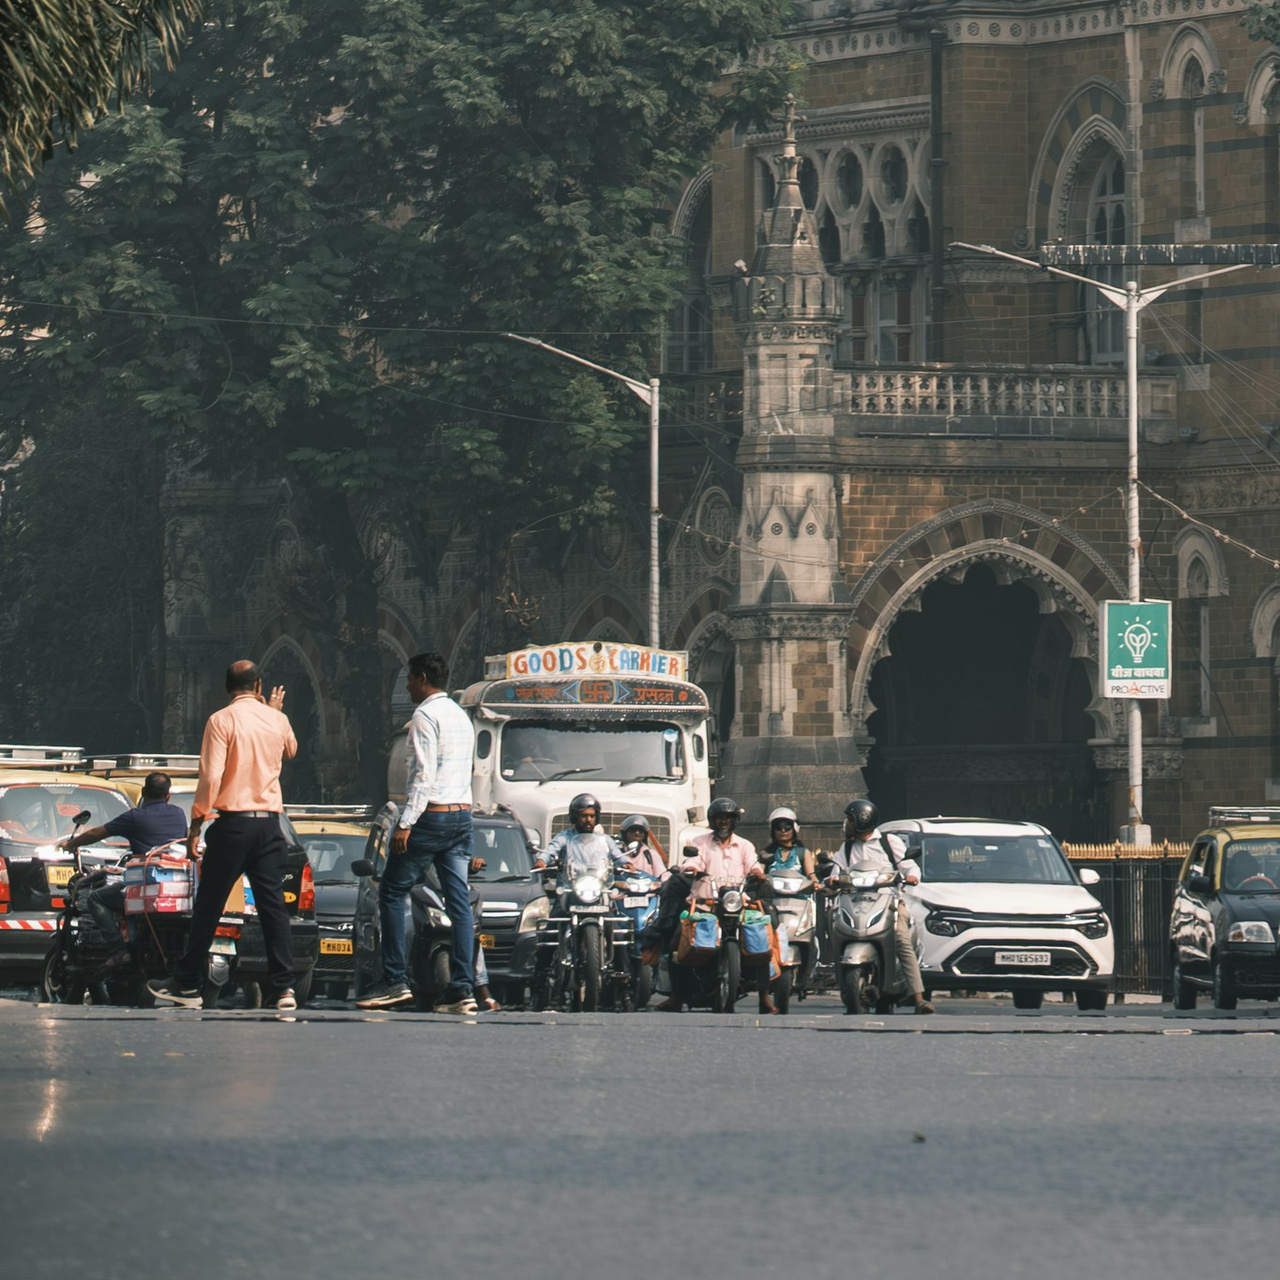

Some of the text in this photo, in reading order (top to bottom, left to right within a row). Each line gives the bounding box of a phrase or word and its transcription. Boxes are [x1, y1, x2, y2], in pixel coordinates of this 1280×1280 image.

[514, 647, 680, 676] GOODS CARRIER
[1111, 682, 1166, 695] PROACTIVE
